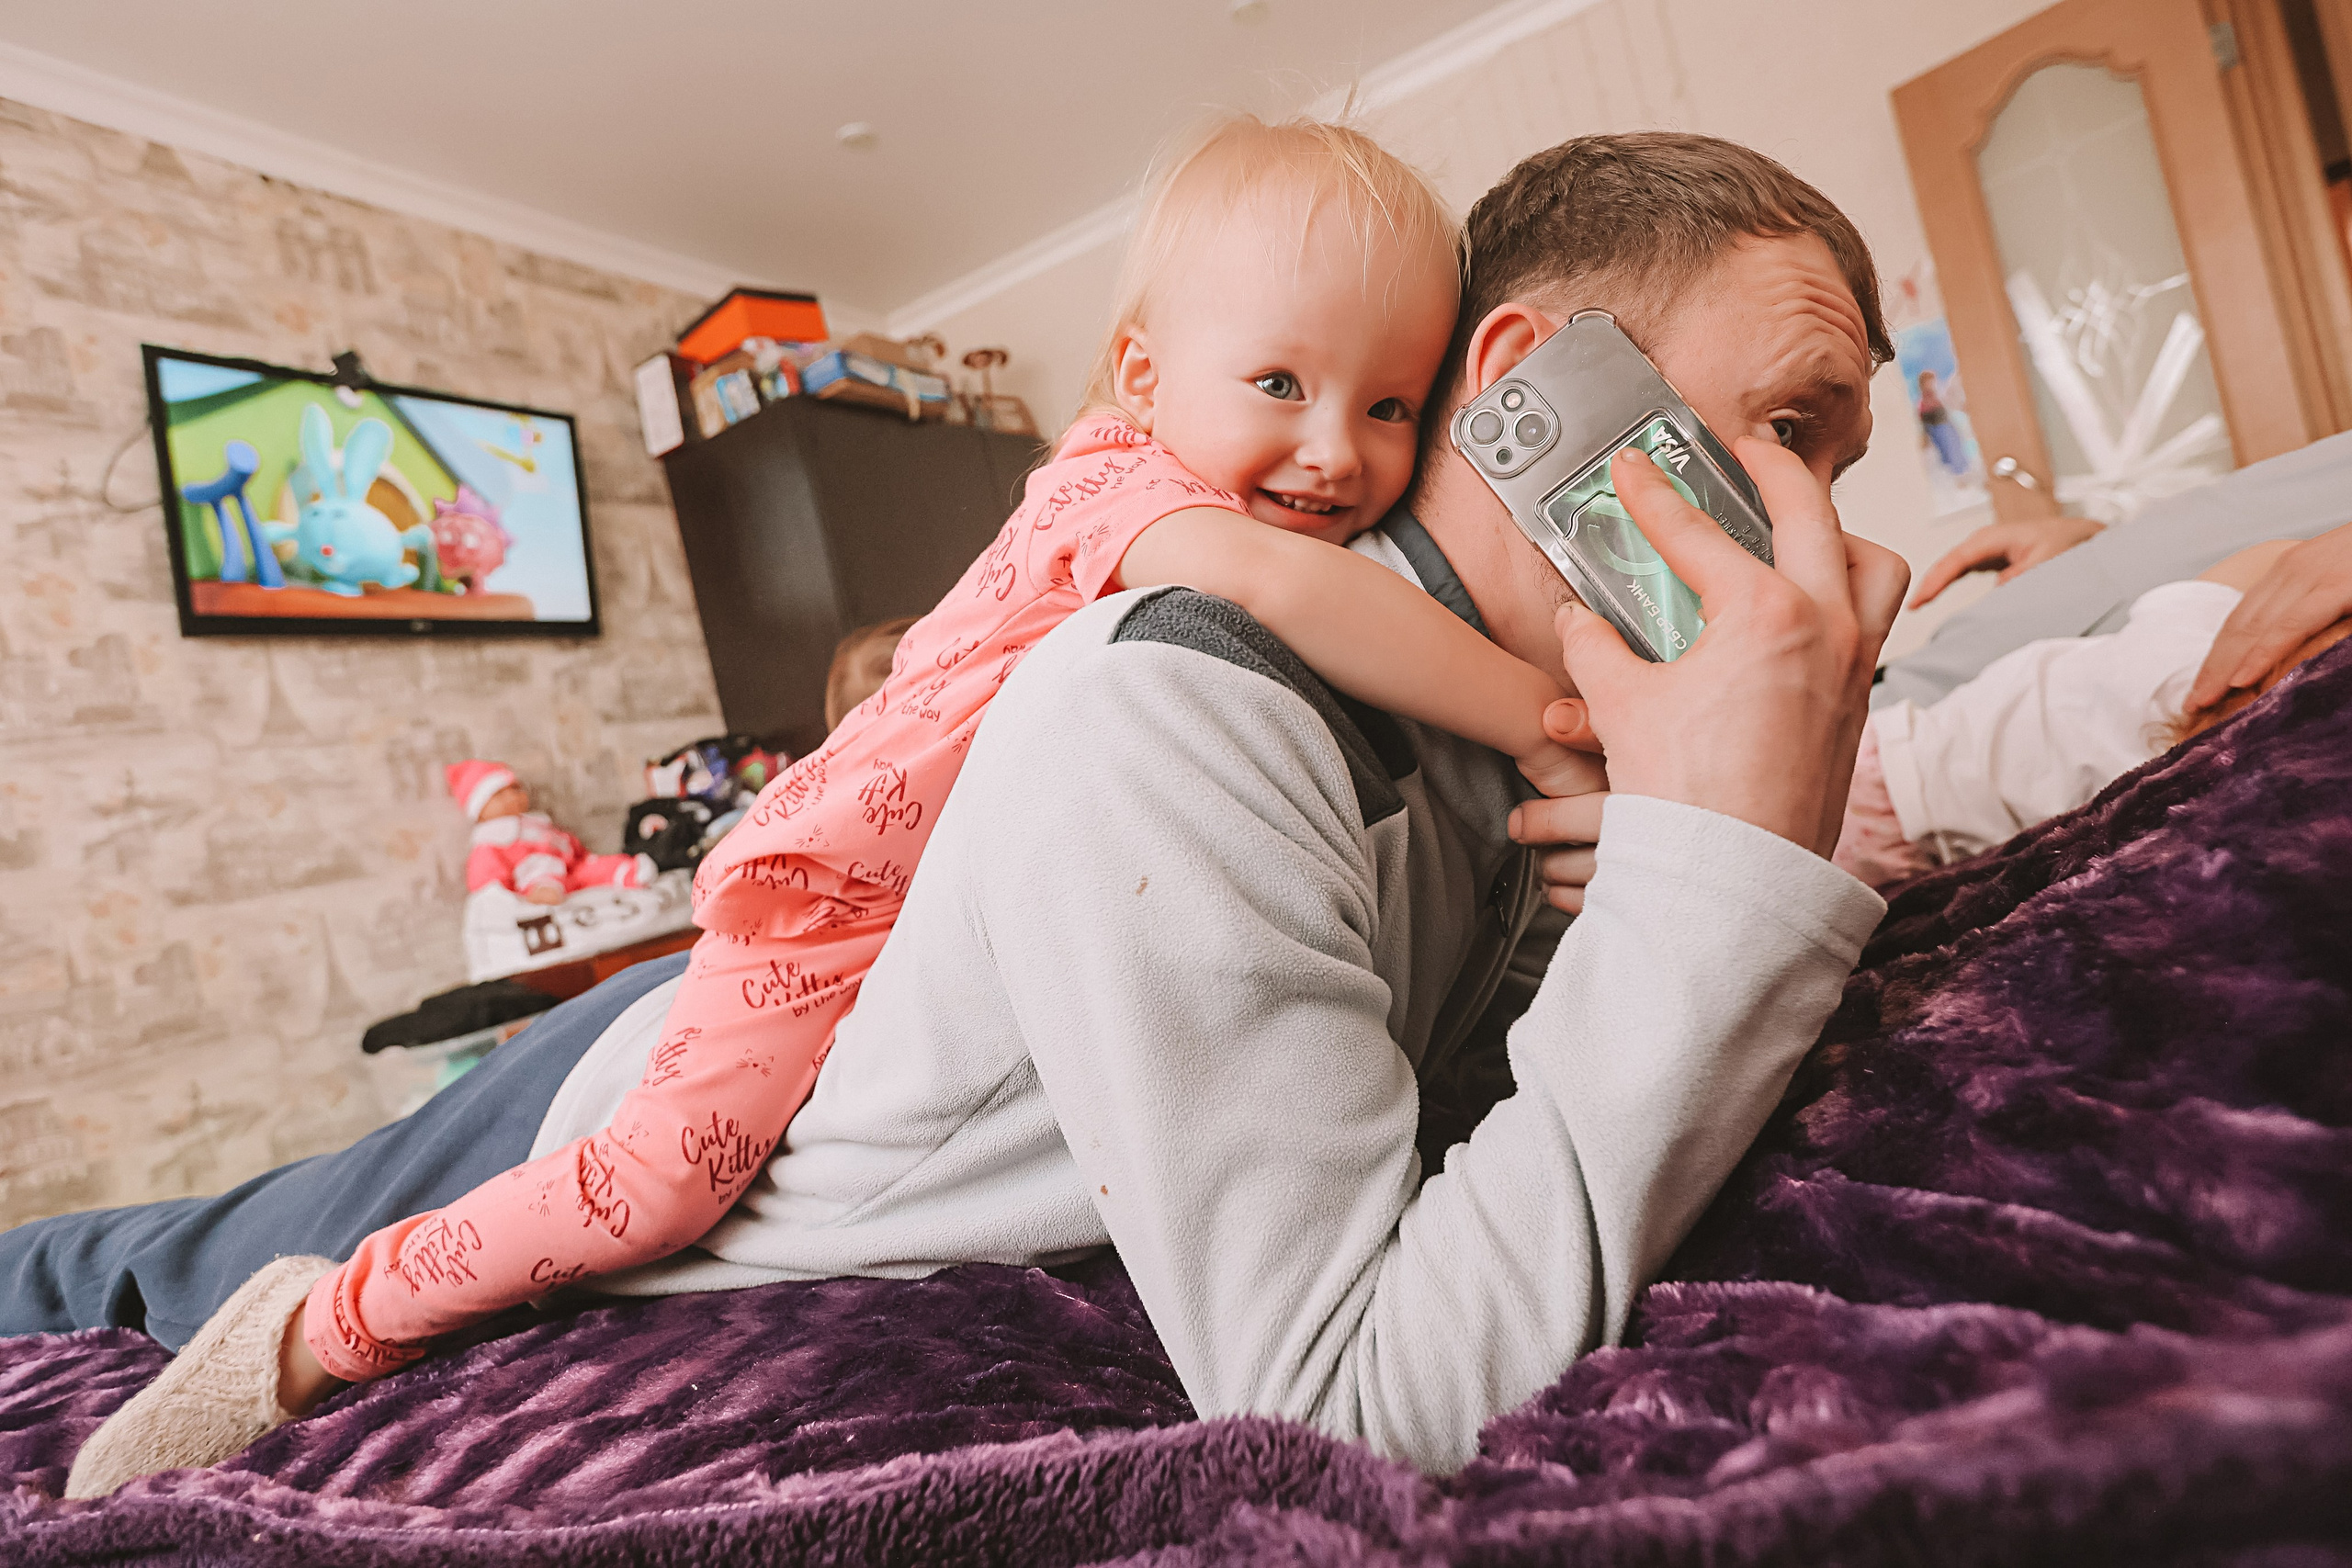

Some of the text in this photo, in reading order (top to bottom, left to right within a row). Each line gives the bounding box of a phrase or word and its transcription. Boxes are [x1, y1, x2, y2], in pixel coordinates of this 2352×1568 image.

[1125, 457, 1147, 474] way
[1651, 425, 1690, 475] VISA
[1627, 579, 1688, 650] СБЕР БАНК
[919, 708, 941, 722] way
[862, 801, 922, 836] Cute
[741, 959, 800, 1009] Cute
[792, 1004, 809, 1018] by
[814, 991, 834, 1009] the
[681, 1111, 740, 1165] Cute
[401, 1218, 454, 1299] Kitty
[445, 1219, 483, 1288] Cute
